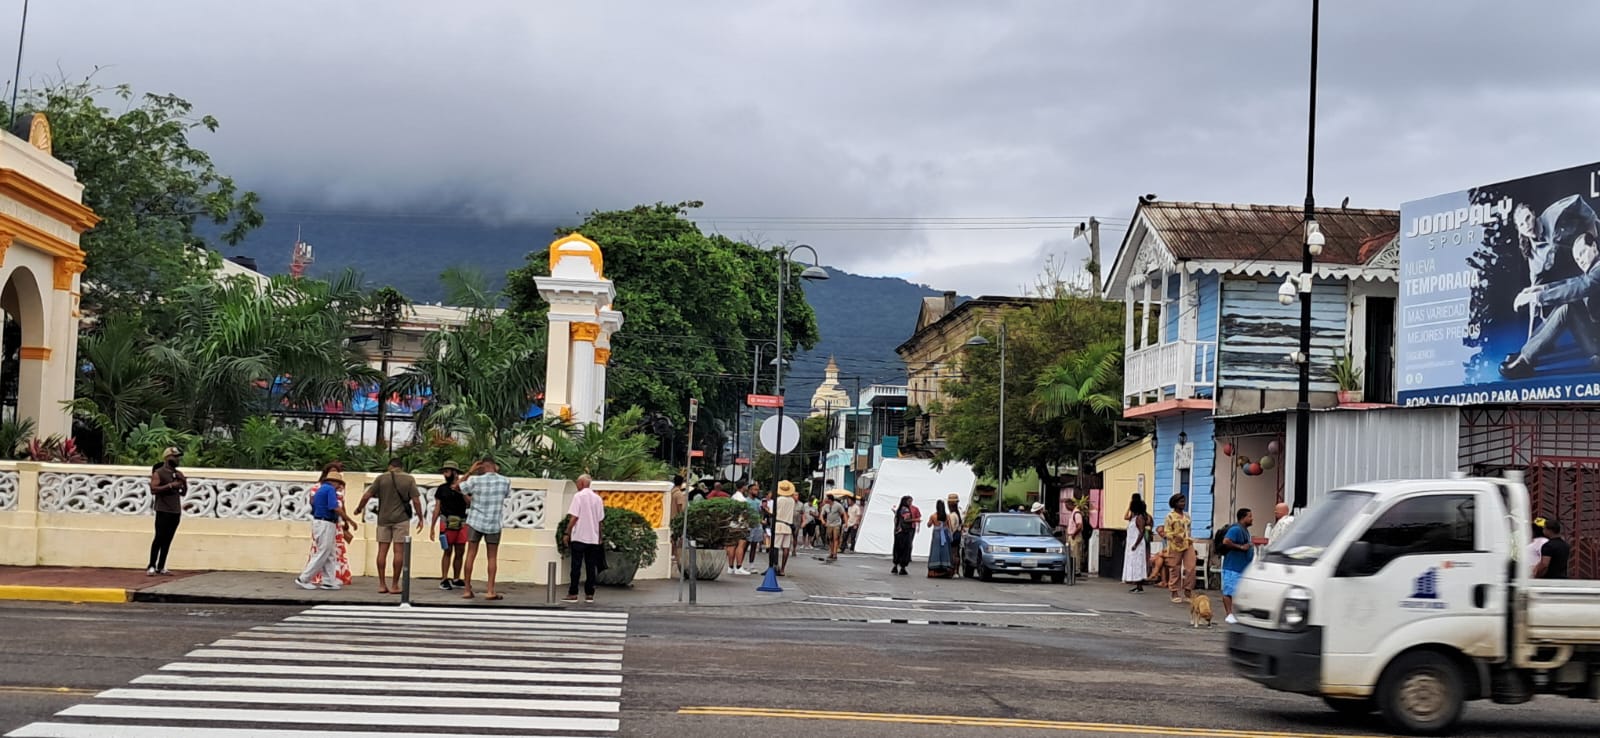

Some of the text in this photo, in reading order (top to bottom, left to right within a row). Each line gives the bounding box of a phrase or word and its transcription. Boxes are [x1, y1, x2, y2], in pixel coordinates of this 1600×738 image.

[1406, 198, 1512, 238] JOMPALY
[1405, 258, 1436, 276] NUEVA
[1405, 269, 1479, 296] TEMPORADA
[1426, 304, 1465, 320] VARIEDAD
[1408, 323, 1480, 344] MEJORES PRECIOS
[1491, 389, 1519, 402] PARA
[1521, 386, 1561, 400] DAMAS
[1565, 385, 1572, 398] Y
[1575, 383, 1600, 397] CAB
